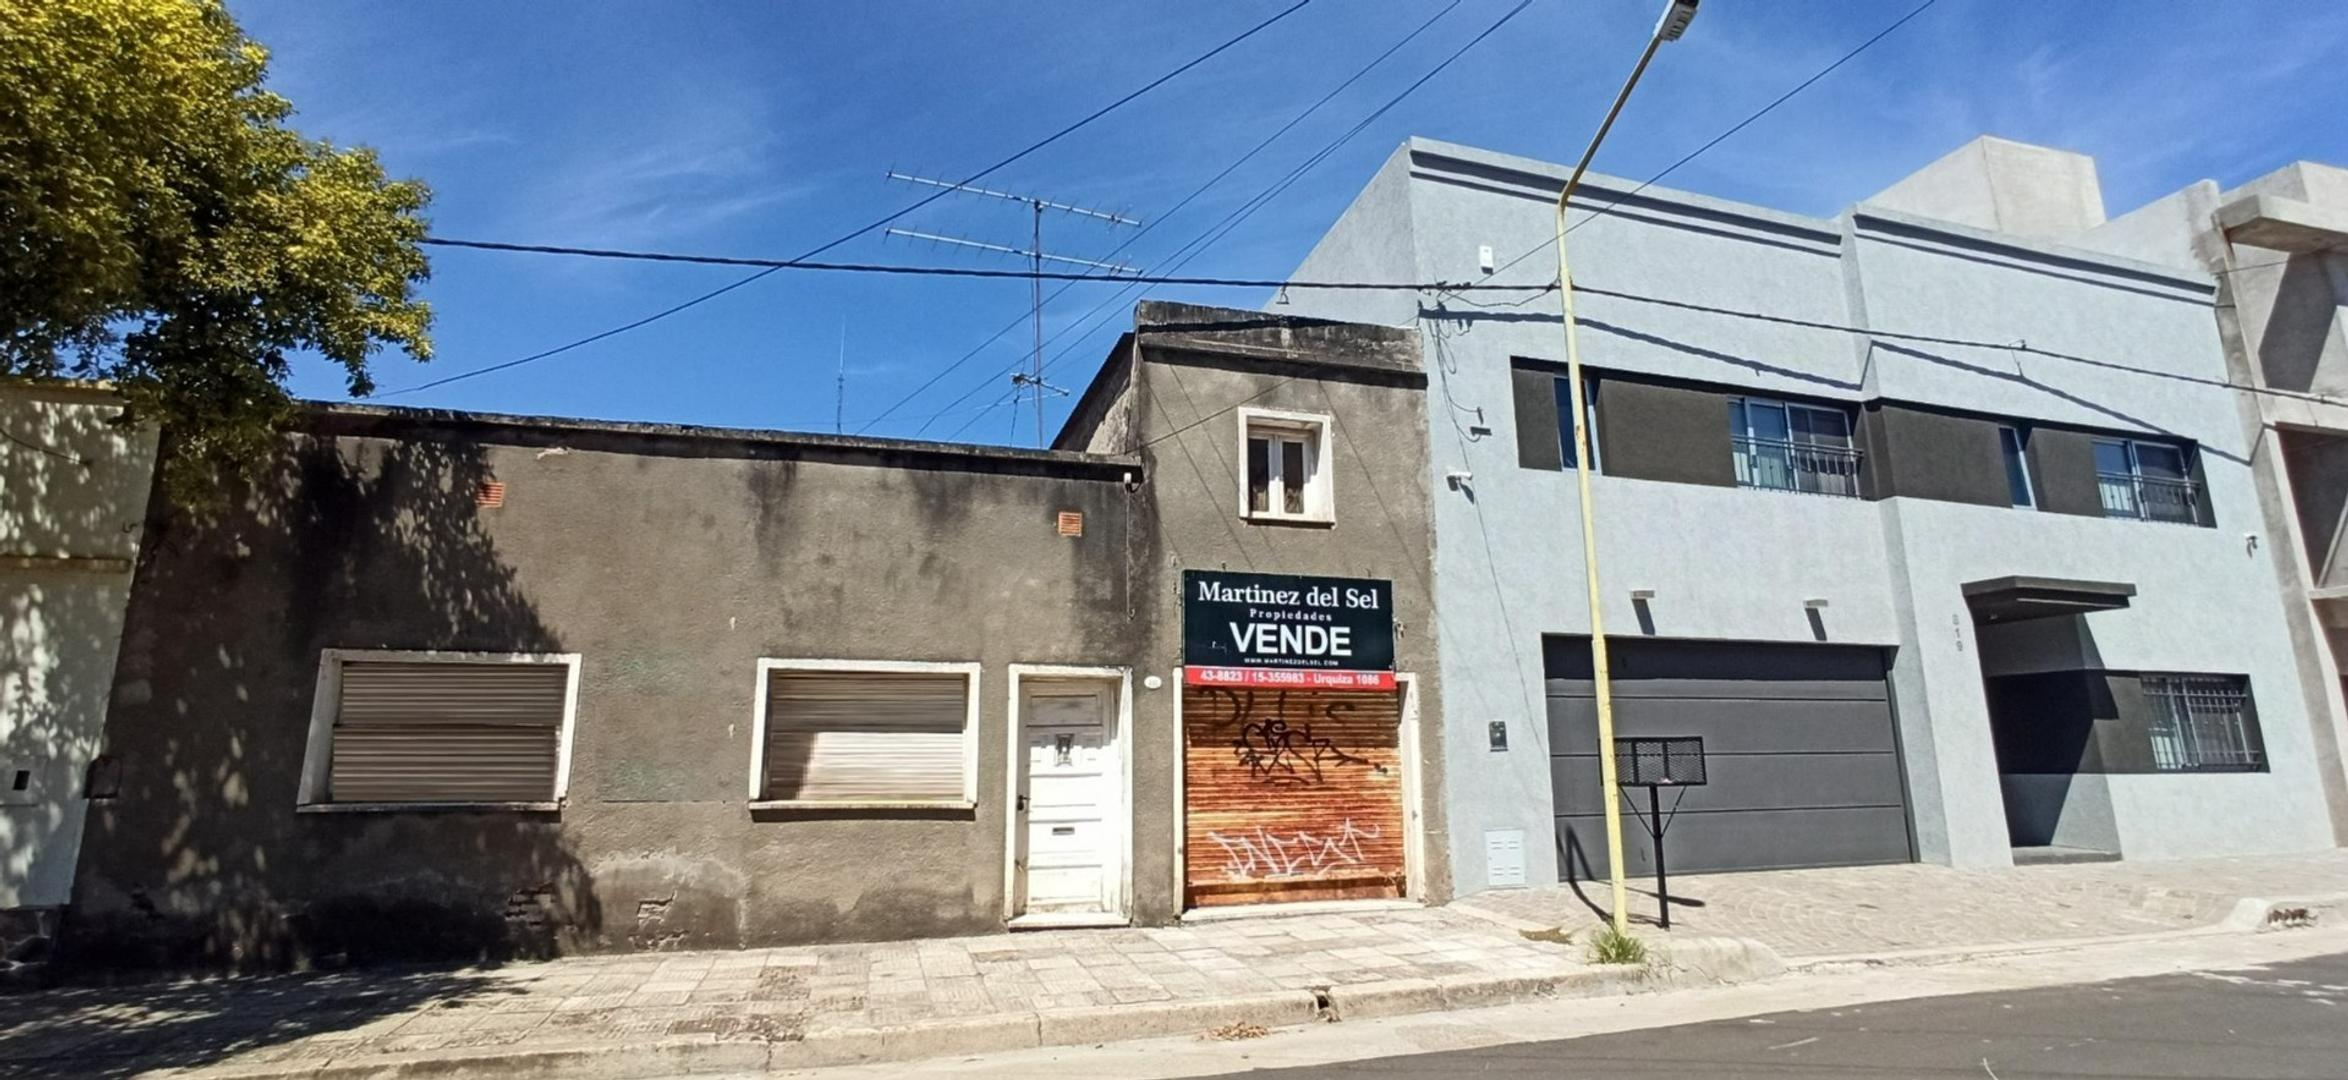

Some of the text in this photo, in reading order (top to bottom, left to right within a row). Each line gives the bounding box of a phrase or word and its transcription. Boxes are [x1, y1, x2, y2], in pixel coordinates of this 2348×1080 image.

[1198, 581, 1379, 609] Martinez del Sel
[1249, 608, 1332, 621] Propiedades
[1229, 621, 1352, 656] VENDE
[1313, 672, 1353, 687] Urquiza
